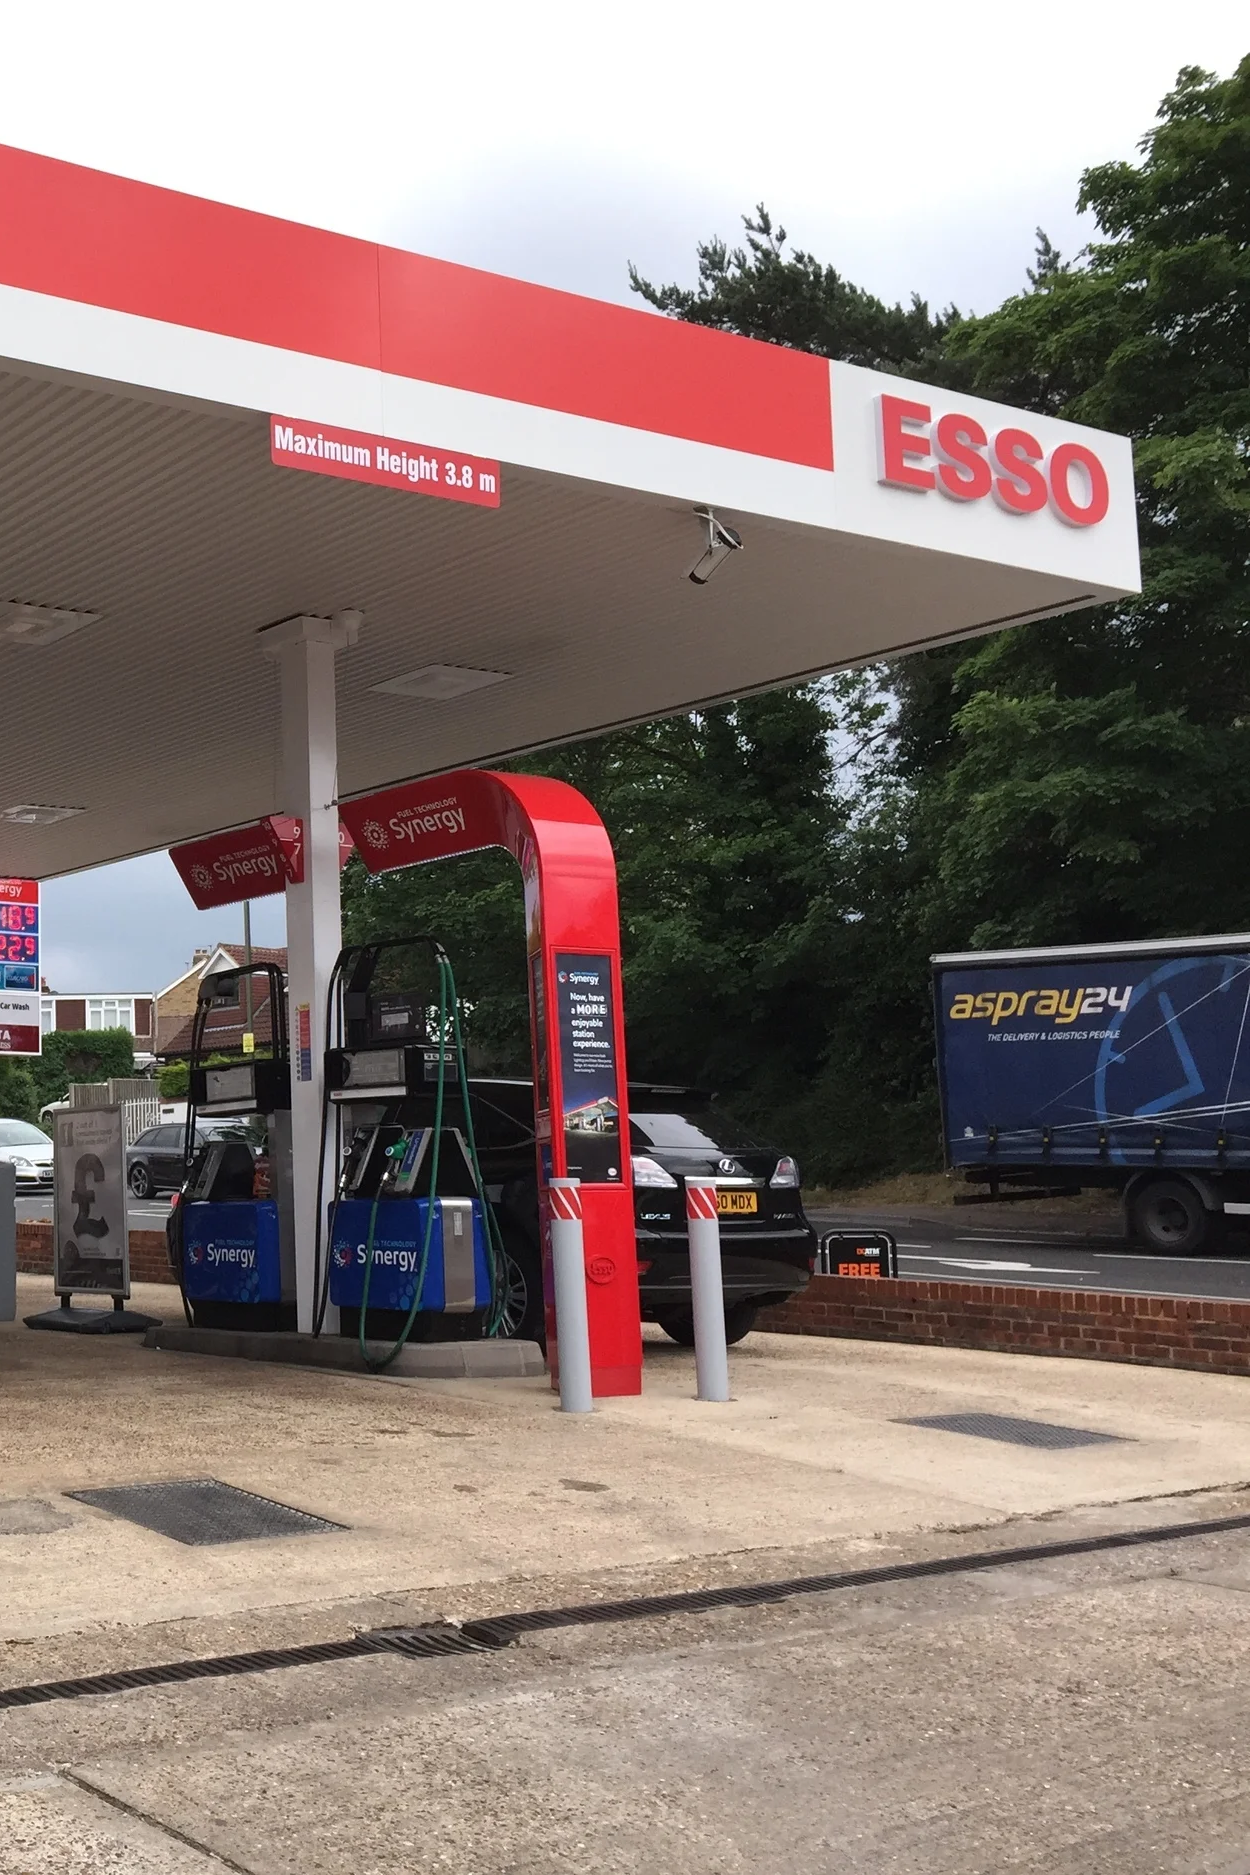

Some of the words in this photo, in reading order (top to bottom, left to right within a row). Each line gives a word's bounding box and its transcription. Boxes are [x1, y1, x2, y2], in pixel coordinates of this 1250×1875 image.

[274, 424, 371, 468] Maximum
[376, 446, 439, 482] Height
[445, 462, 473, 489] 3.8
[479, 472, 495, 493] m
[876, 393, 1109, 526] ESSO
[397, 809, 414, 818] FUEL
[414, 796, 458, 815] TECHNOLOGY
[389, 807, 466, 843] Synergy
[293, 826, 301, 839] 9
[293, 842, 301, 855] 7
[213, 854, 278, 884] Synergy
[569, 973, 599, 985] Synergy
[570, 992, 587, 1002] Now,
[588, 993, 605, 1002] have
[0, 1002, 11, 1010] Car
[12, 1003, 30, 1011] Wash
[577, 1004, 607, 1015] MORE
[950, 986, 1132, 1026] aspray24
[571, 1018, 603, 1028] enjoyable
[572, 1029, 595, 1038] station
[988, 1033, 1002, 1042] THE
[1003, 1033, 1039, 1042] DELIVERY
[1040, 1032, 1046, 1041] &
[1048, 1031, 1088, 1041] LOGISTICS
[1089, 1030, 1121, 1039] PEOPLE
[573, 1039, 610, 1049] experience.
[731, 1195, 753, 1209] MDX
[207, 1243, 255, 1268] Synergy
[839, 1263, 880, 1277] FREE
